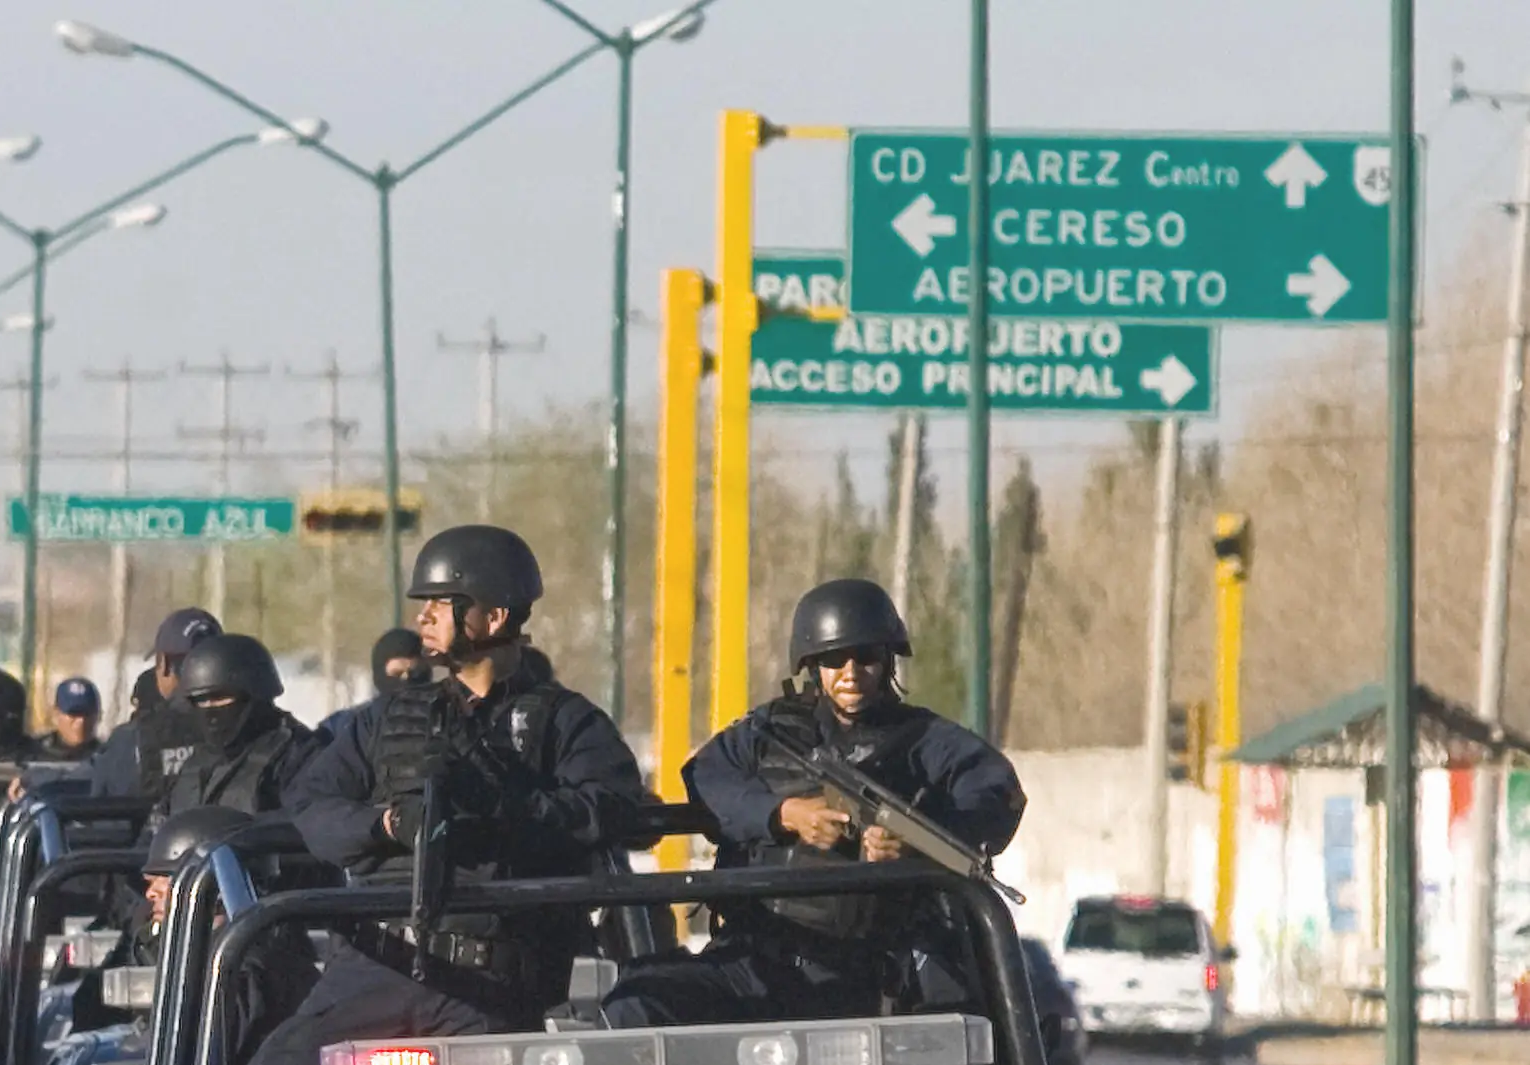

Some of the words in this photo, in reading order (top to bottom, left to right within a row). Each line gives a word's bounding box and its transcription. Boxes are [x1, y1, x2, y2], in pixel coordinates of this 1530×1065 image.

[872, 147, 927, 183] CD
[993, 208, 1187, 248] CERESO
[913, 266, 1227, 306] AEROPUERTO
[751, 358, 902, 394] ACCESO
[921, 360, 1123, 399] PRNCIPAL
